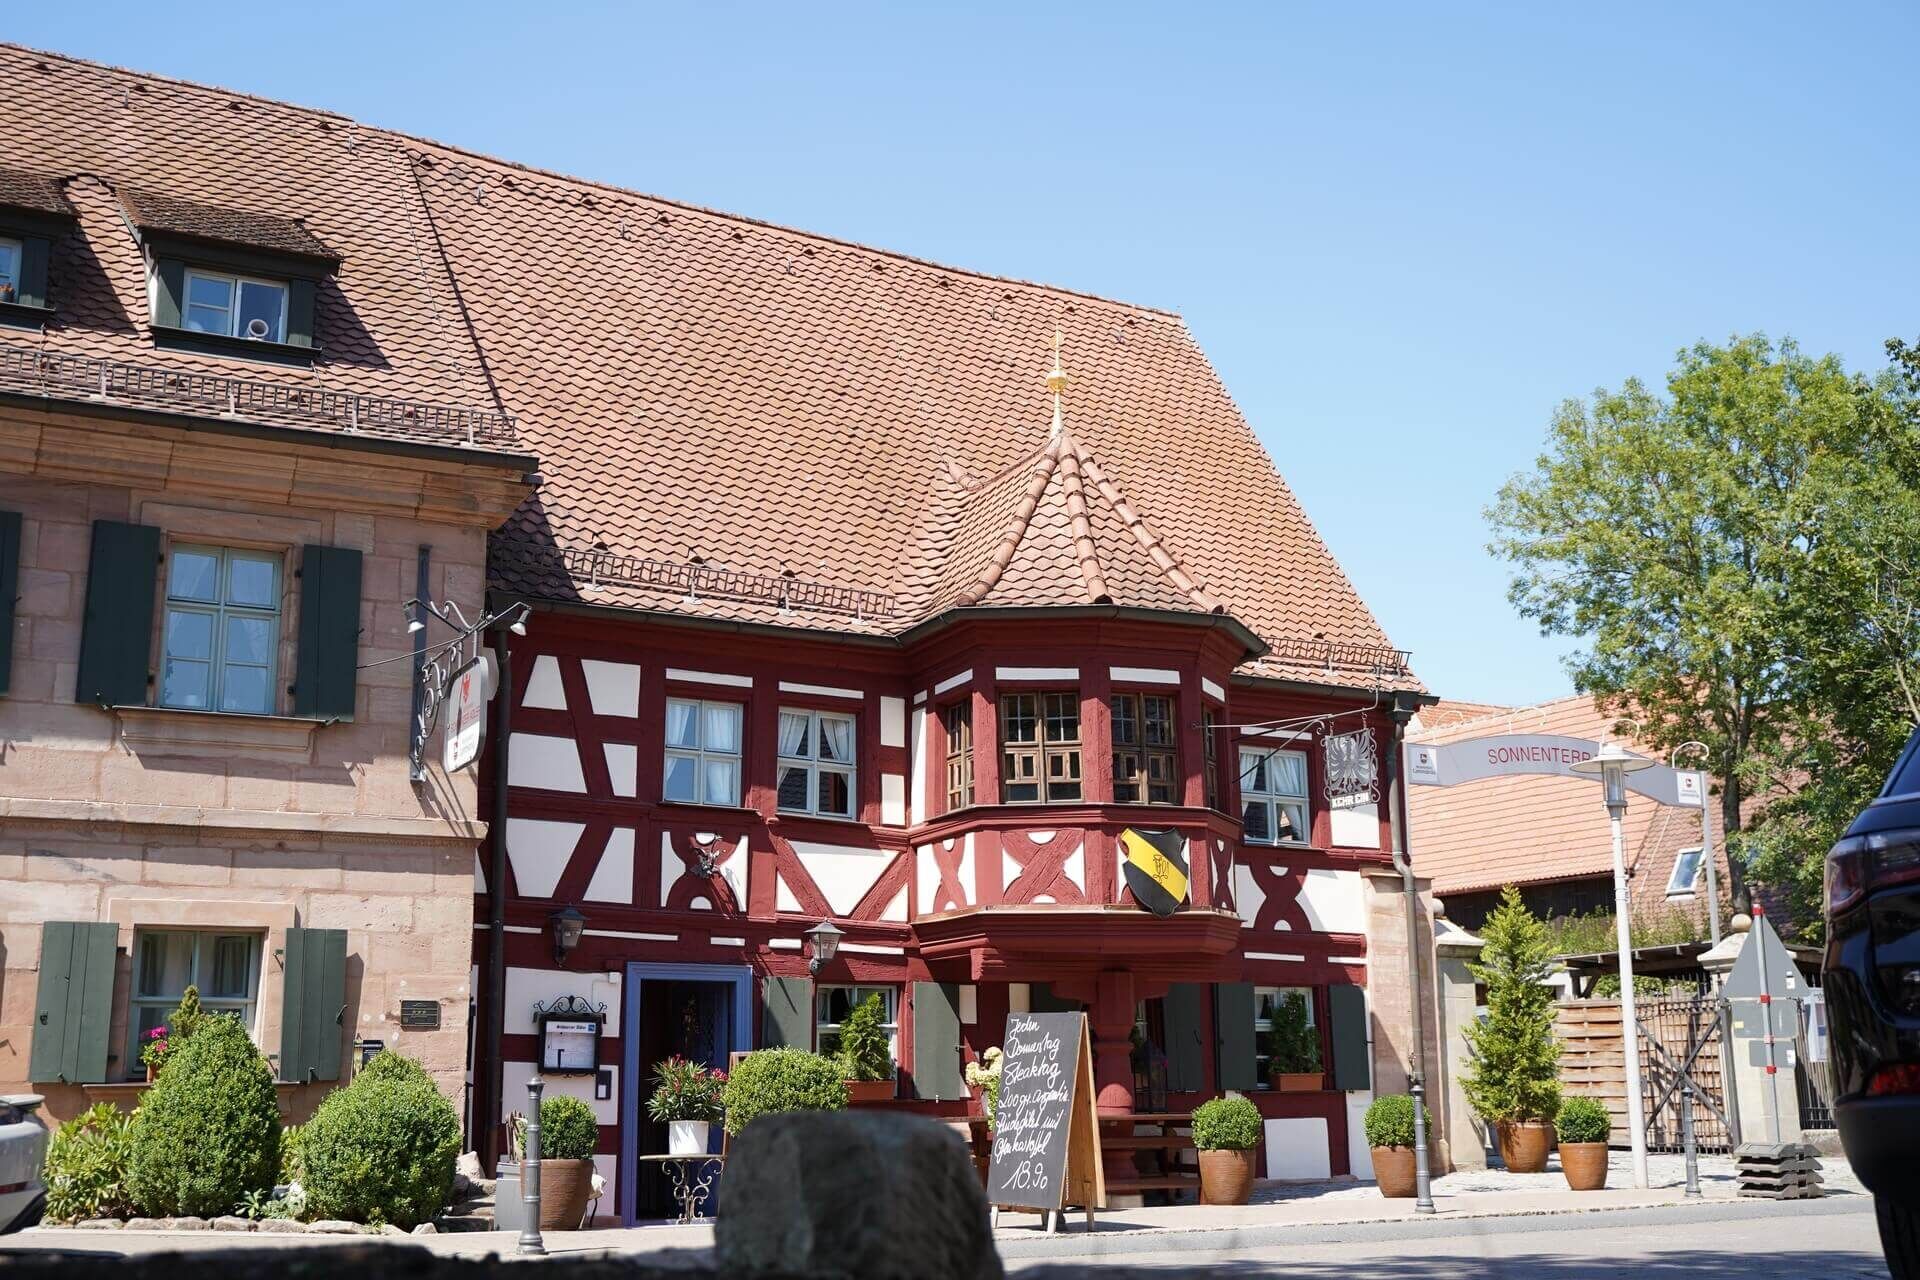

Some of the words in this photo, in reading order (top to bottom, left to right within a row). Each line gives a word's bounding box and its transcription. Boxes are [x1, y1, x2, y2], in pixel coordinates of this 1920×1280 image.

[1487, 746, 1597, 765] SONNENTERR
[1009, 1016, 1039, 1038] Jeden
[1006, 1032, 1060, 1060] Donnerstag
[1004, 1056, 1061, 1089] Steaktag
[1041, 1109, 1064, 1130] mit
